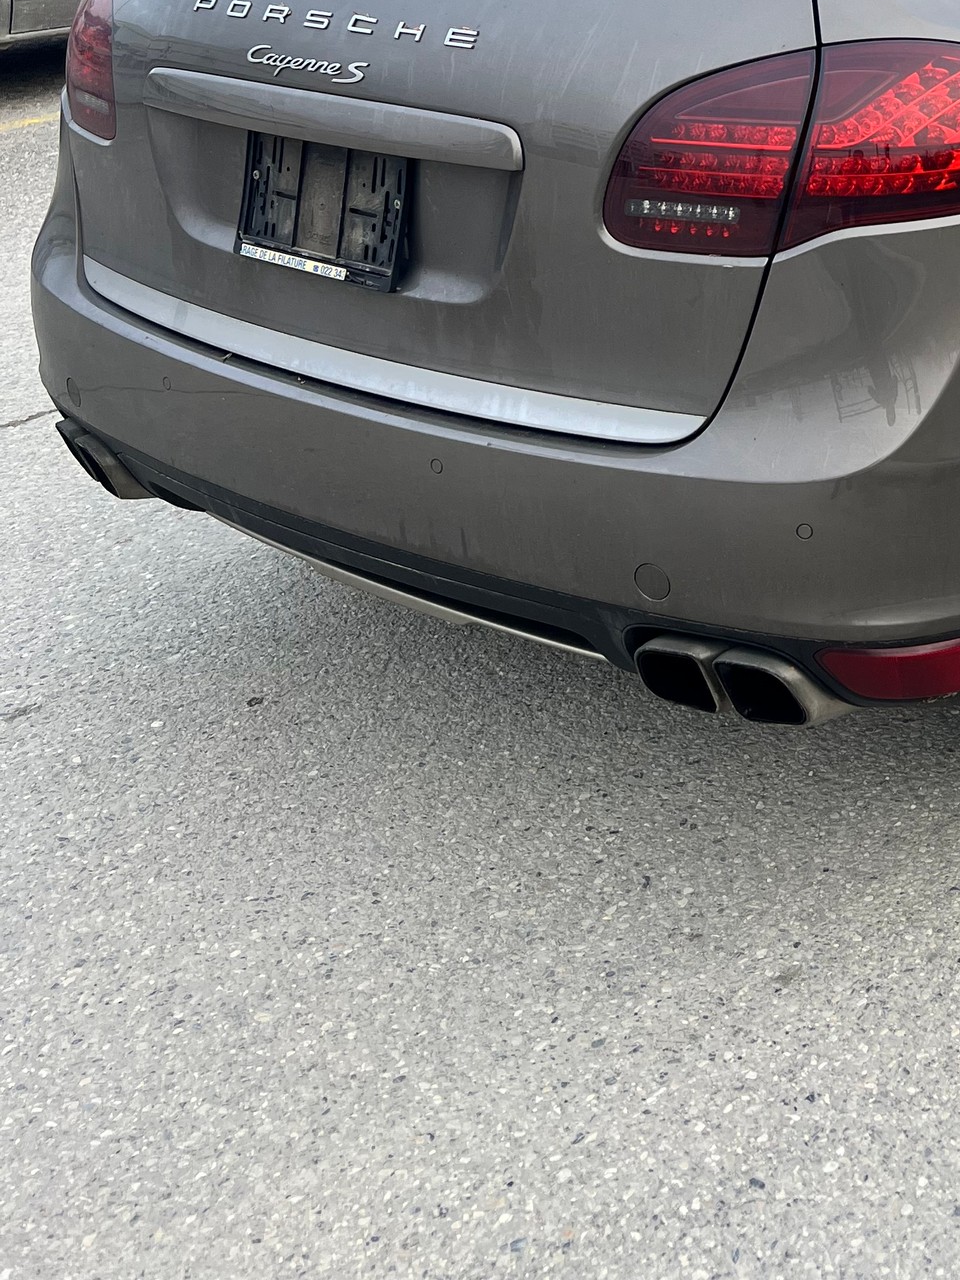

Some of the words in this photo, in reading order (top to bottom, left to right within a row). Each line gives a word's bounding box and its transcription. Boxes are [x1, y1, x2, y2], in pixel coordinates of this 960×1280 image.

[247, 44, 342, 77] Cayenne
[331, 62, 371, 83] S
[241, 245, 258, 257] RAGE
[259, 249, 267, 260] DE
[268, 252, 276, 262] LA
[278, 254, 307, 269] FILATURE
[320, 265, 332, 276] 022
